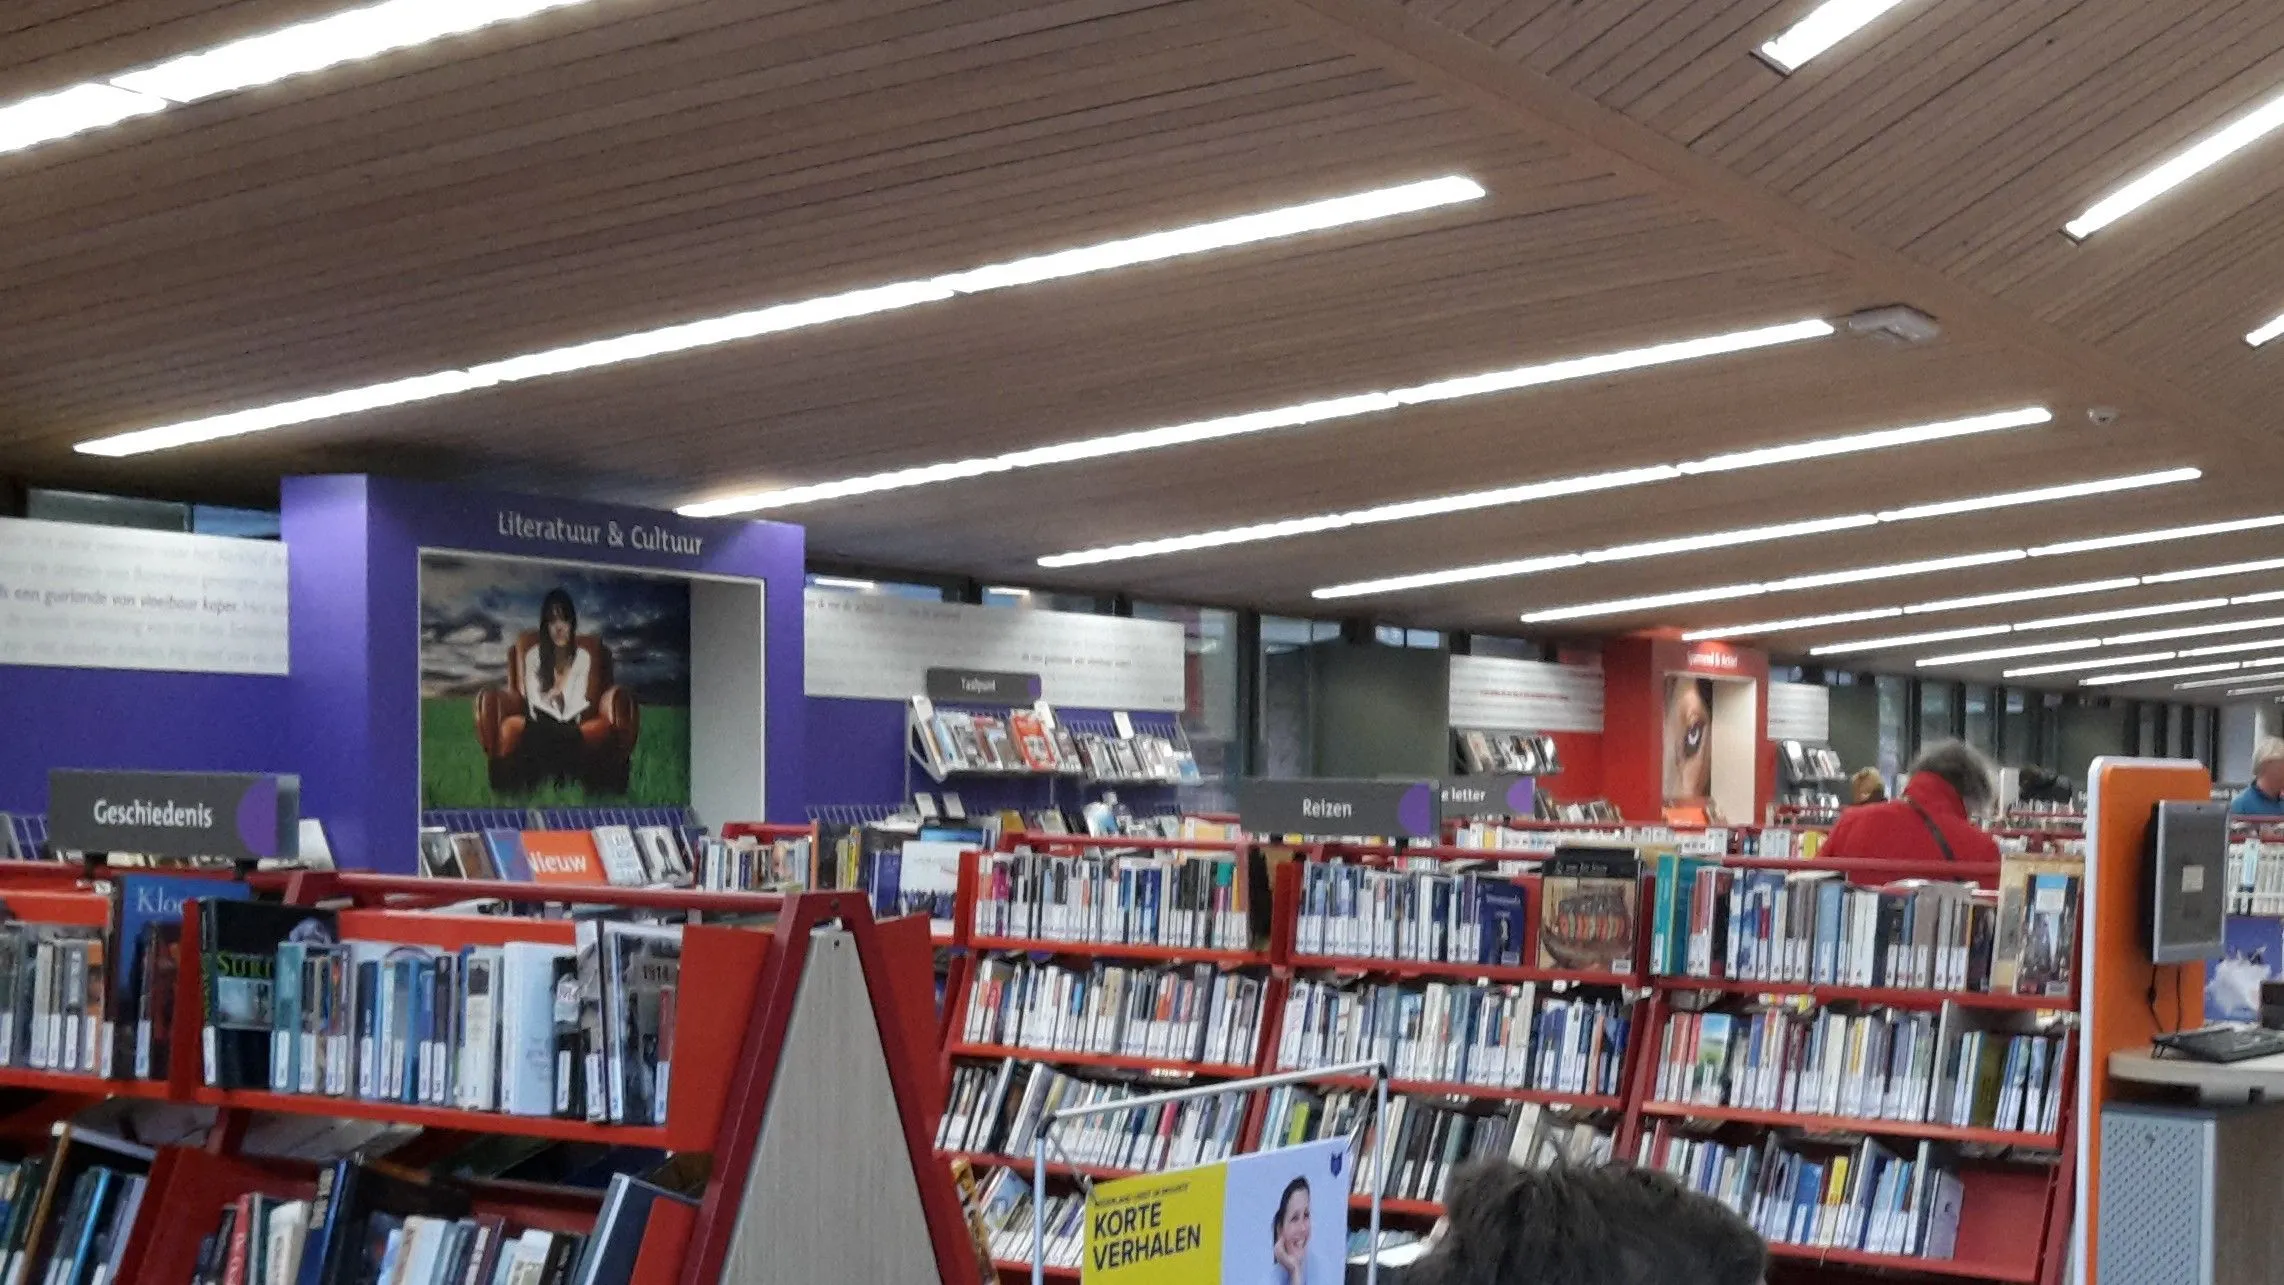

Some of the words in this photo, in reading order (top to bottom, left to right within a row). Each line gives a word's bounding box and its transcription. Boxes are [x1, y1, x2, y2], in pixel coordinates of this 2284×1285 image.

[498, 509, 600, 545] Literatuur
[607, 519, 625, 549] &
[631, 524, 703, 556] Cultuur
[1302, 797, 1353, 818] Reizen
[1452, 786, 1487, 803] letter
[93, 798, 214, 829] Geschiedenis
[1094, 1201, 1161, 1240] KORTE
[1093, 1223, 1201, 1272] VERHALEN
